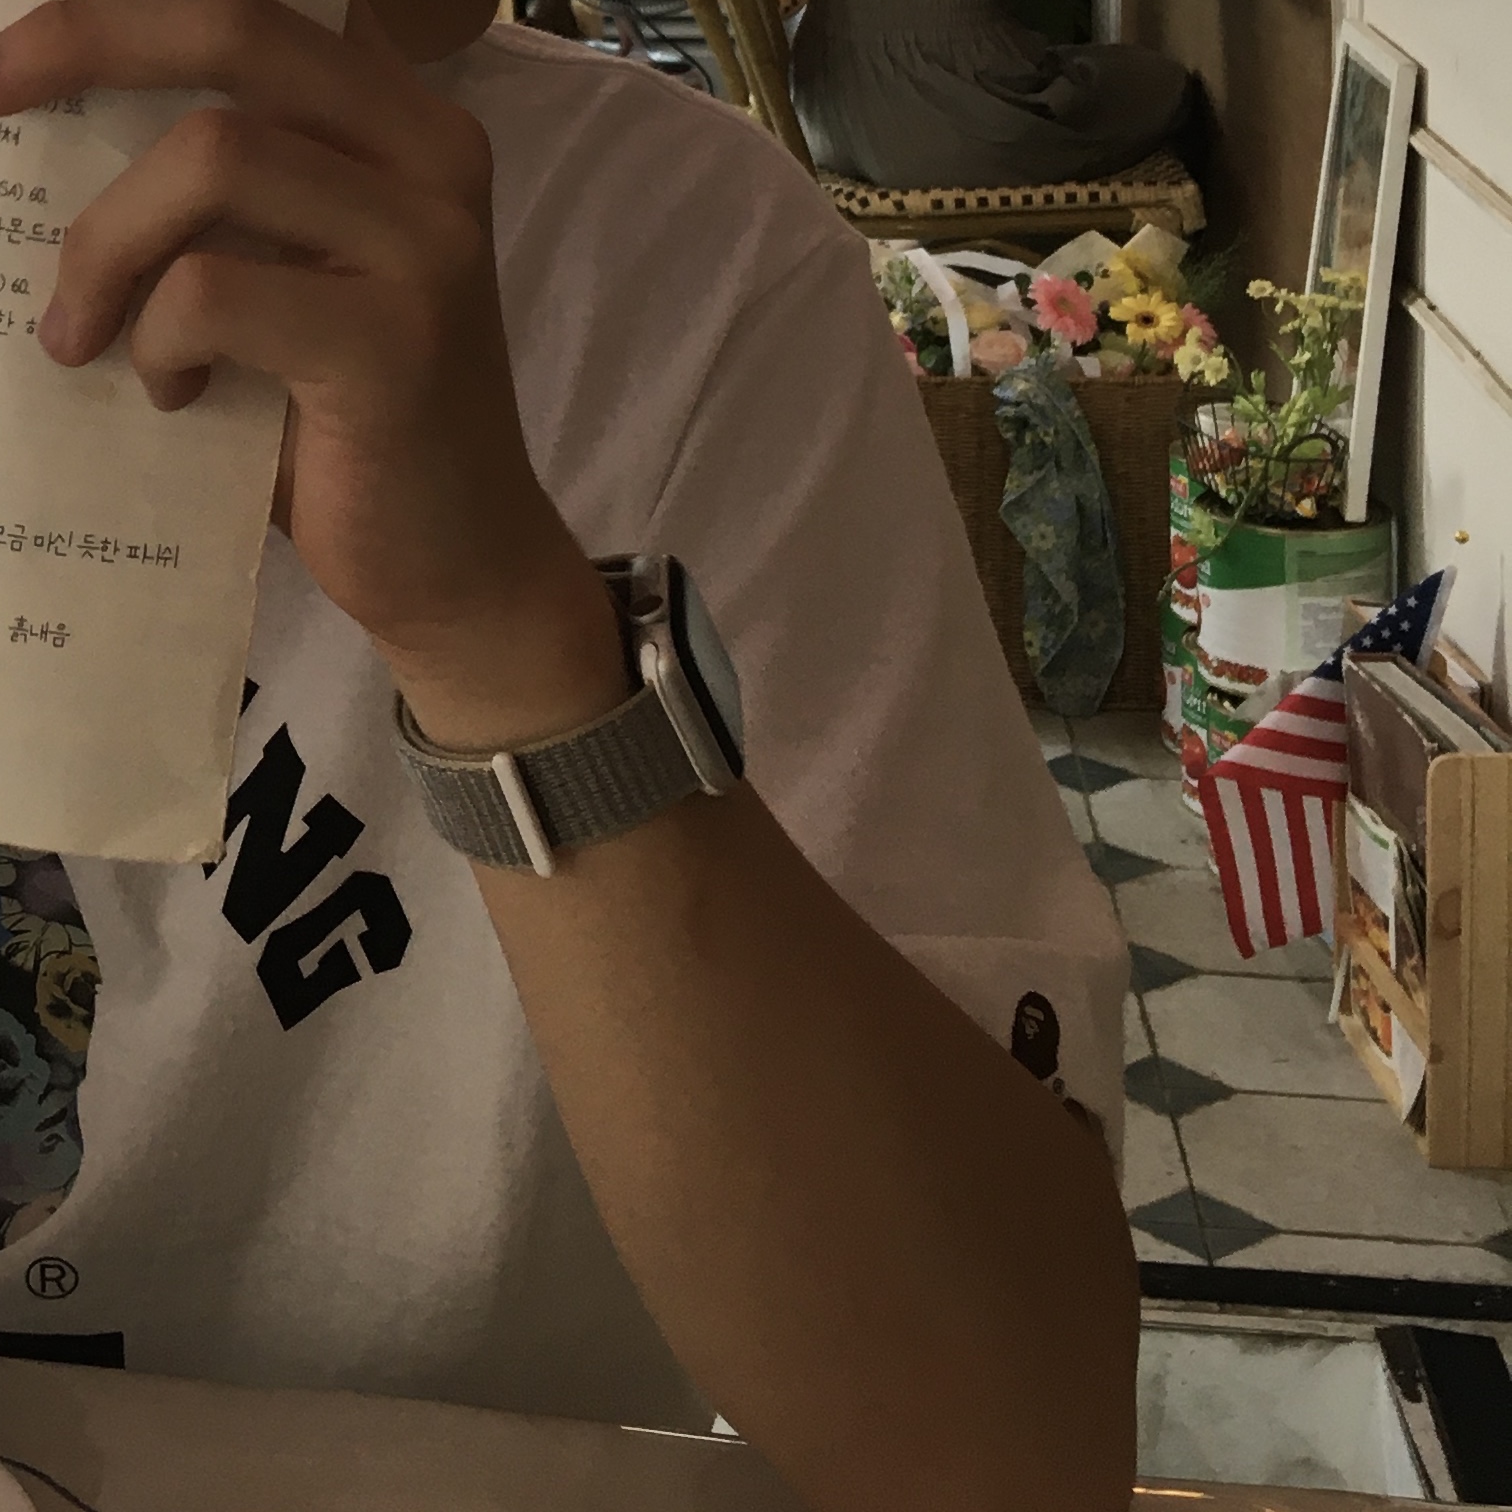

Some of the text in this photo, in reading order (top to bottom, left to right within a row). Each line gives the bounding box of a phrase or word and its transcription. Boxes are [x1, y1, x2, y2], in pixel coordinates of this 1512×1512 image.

[34, 531, 74, 557] 마신
[76, 534, 120, 563] 듯한
[8, 615, 71, 648] 흙내음
